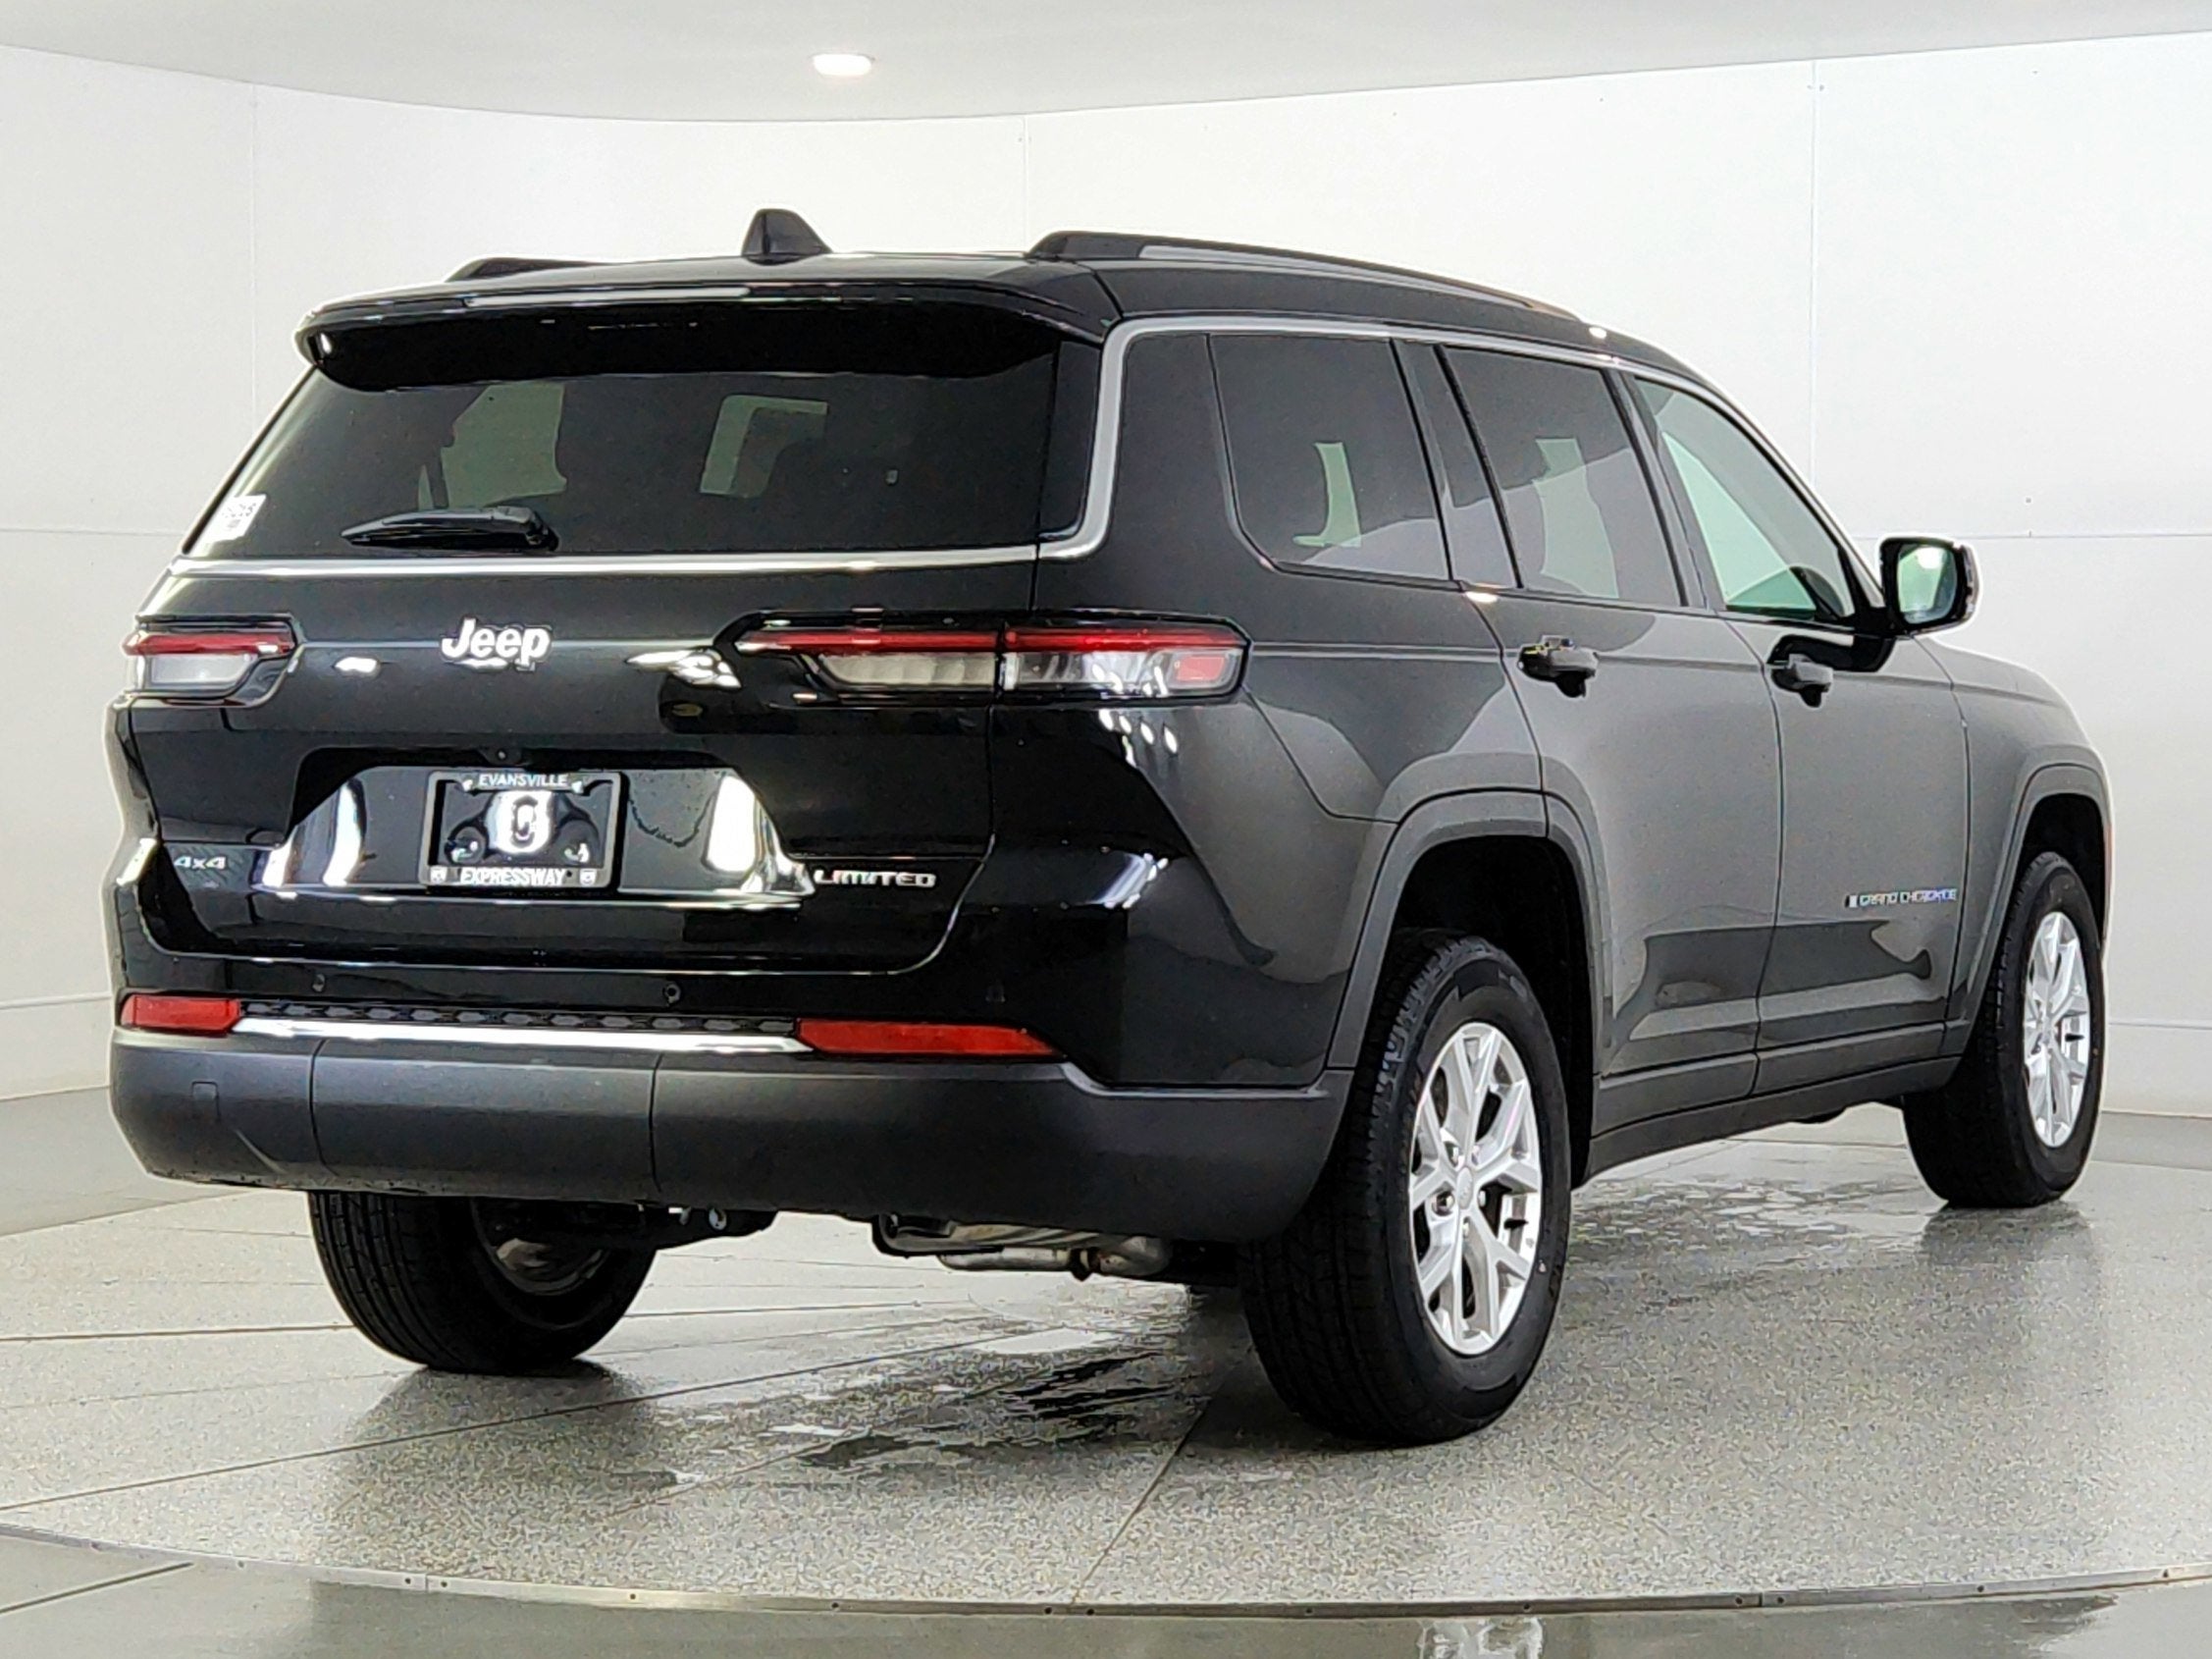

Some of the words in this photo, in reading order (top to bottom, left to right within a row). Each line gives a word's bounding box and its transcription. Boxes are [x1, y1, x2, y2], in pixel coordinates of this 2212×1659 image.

[441, 617, 551, 669] Jeep
[478, 774, 569, 786] EVANSVILLE
[174, 856, 226, 870] 4x4
[459, 868, 568, 886] EXPRESSWAY
[814, 870, 937, 887] LIMITED
